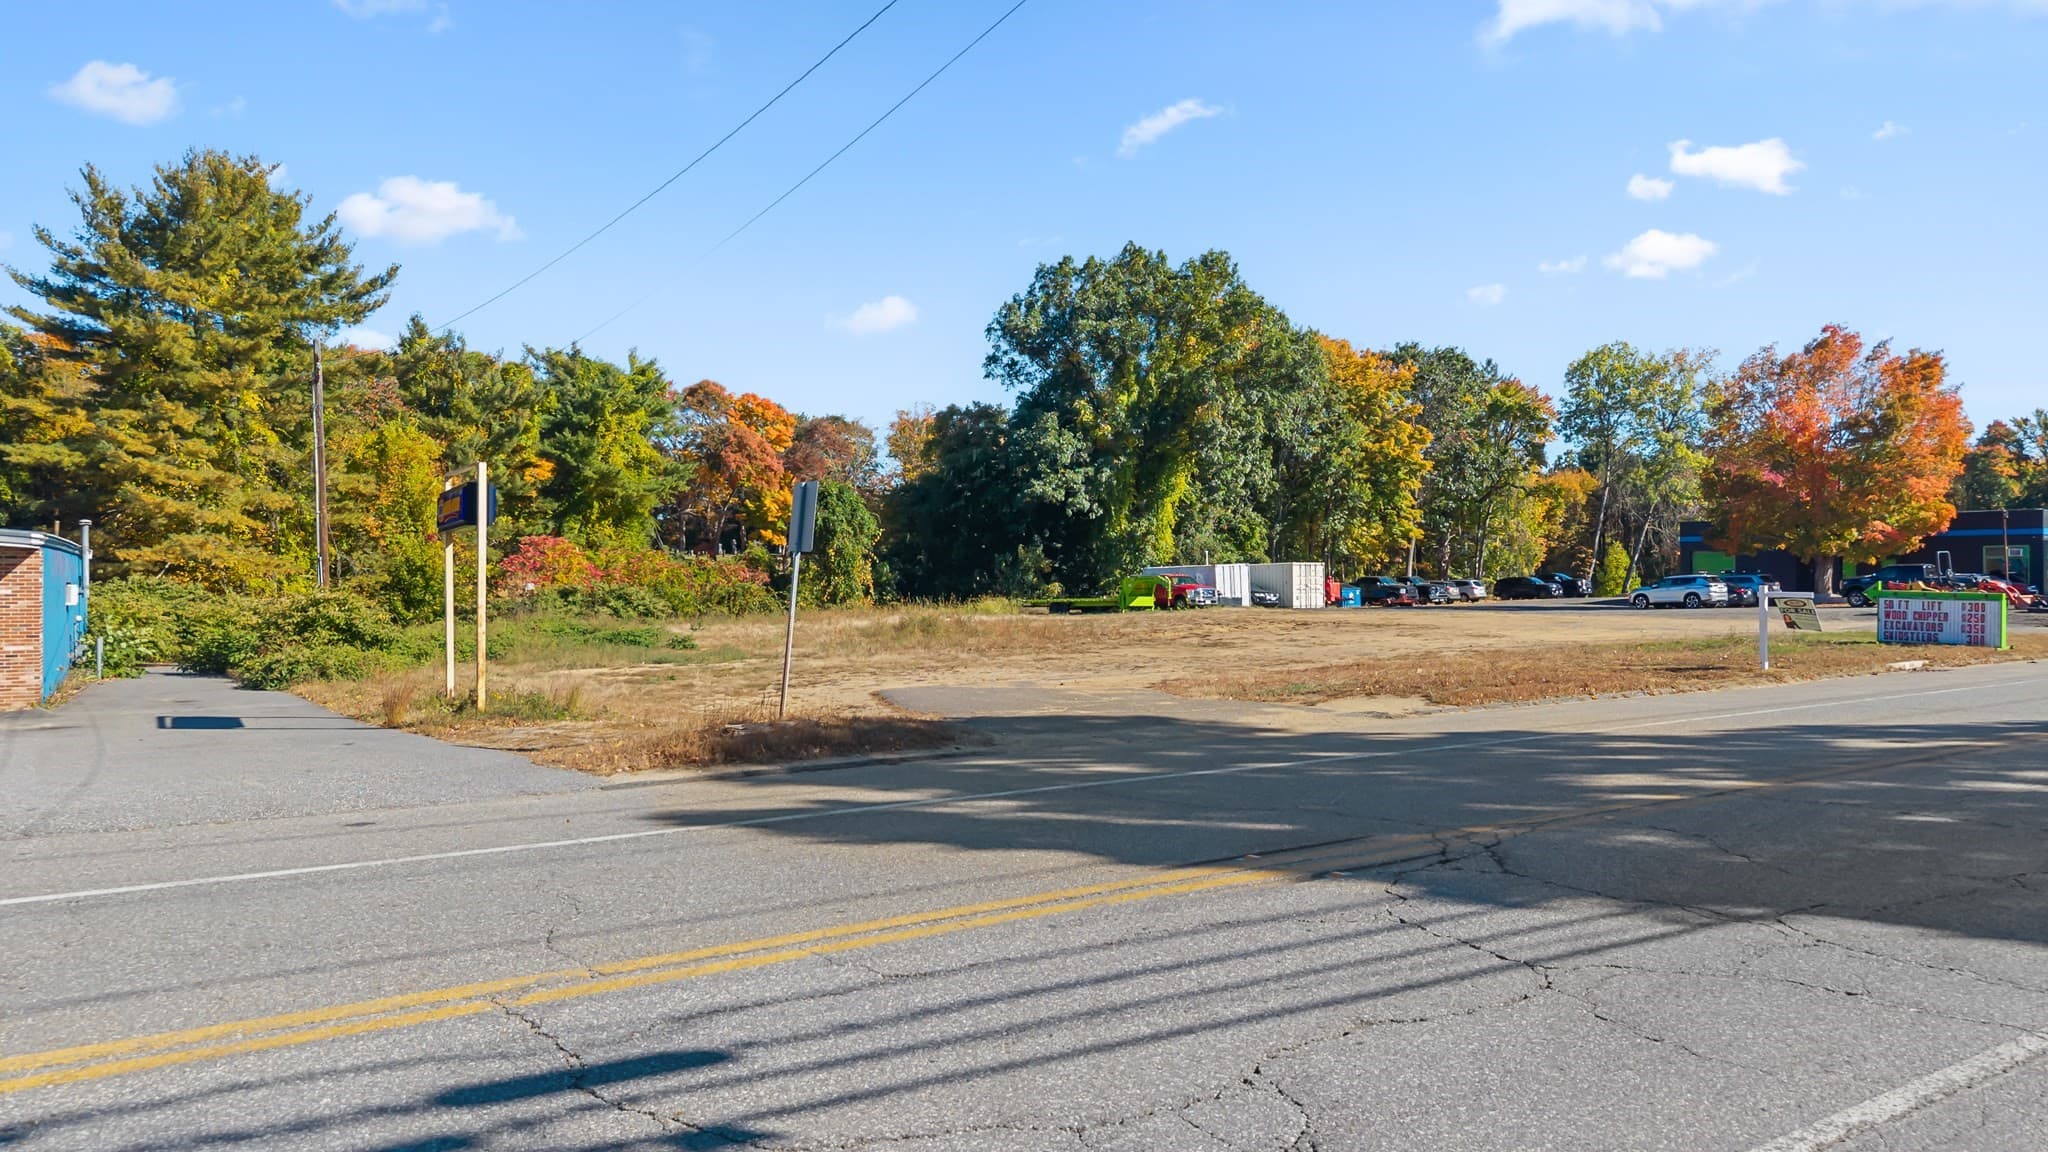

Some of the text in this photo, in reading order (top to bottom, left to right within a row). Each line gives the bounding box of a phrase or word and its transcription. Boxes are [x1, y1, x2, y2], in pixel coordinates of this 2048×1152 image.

[1898, 600, 1909, 609] FT
[1922, 601, 1943, 611] LIFT
[1884, 610, 1907, 620] WOOD
[1913, 611, 1949, 621] CHIPPER
[1884, 620, 1943, 632] EXCAVATORS
